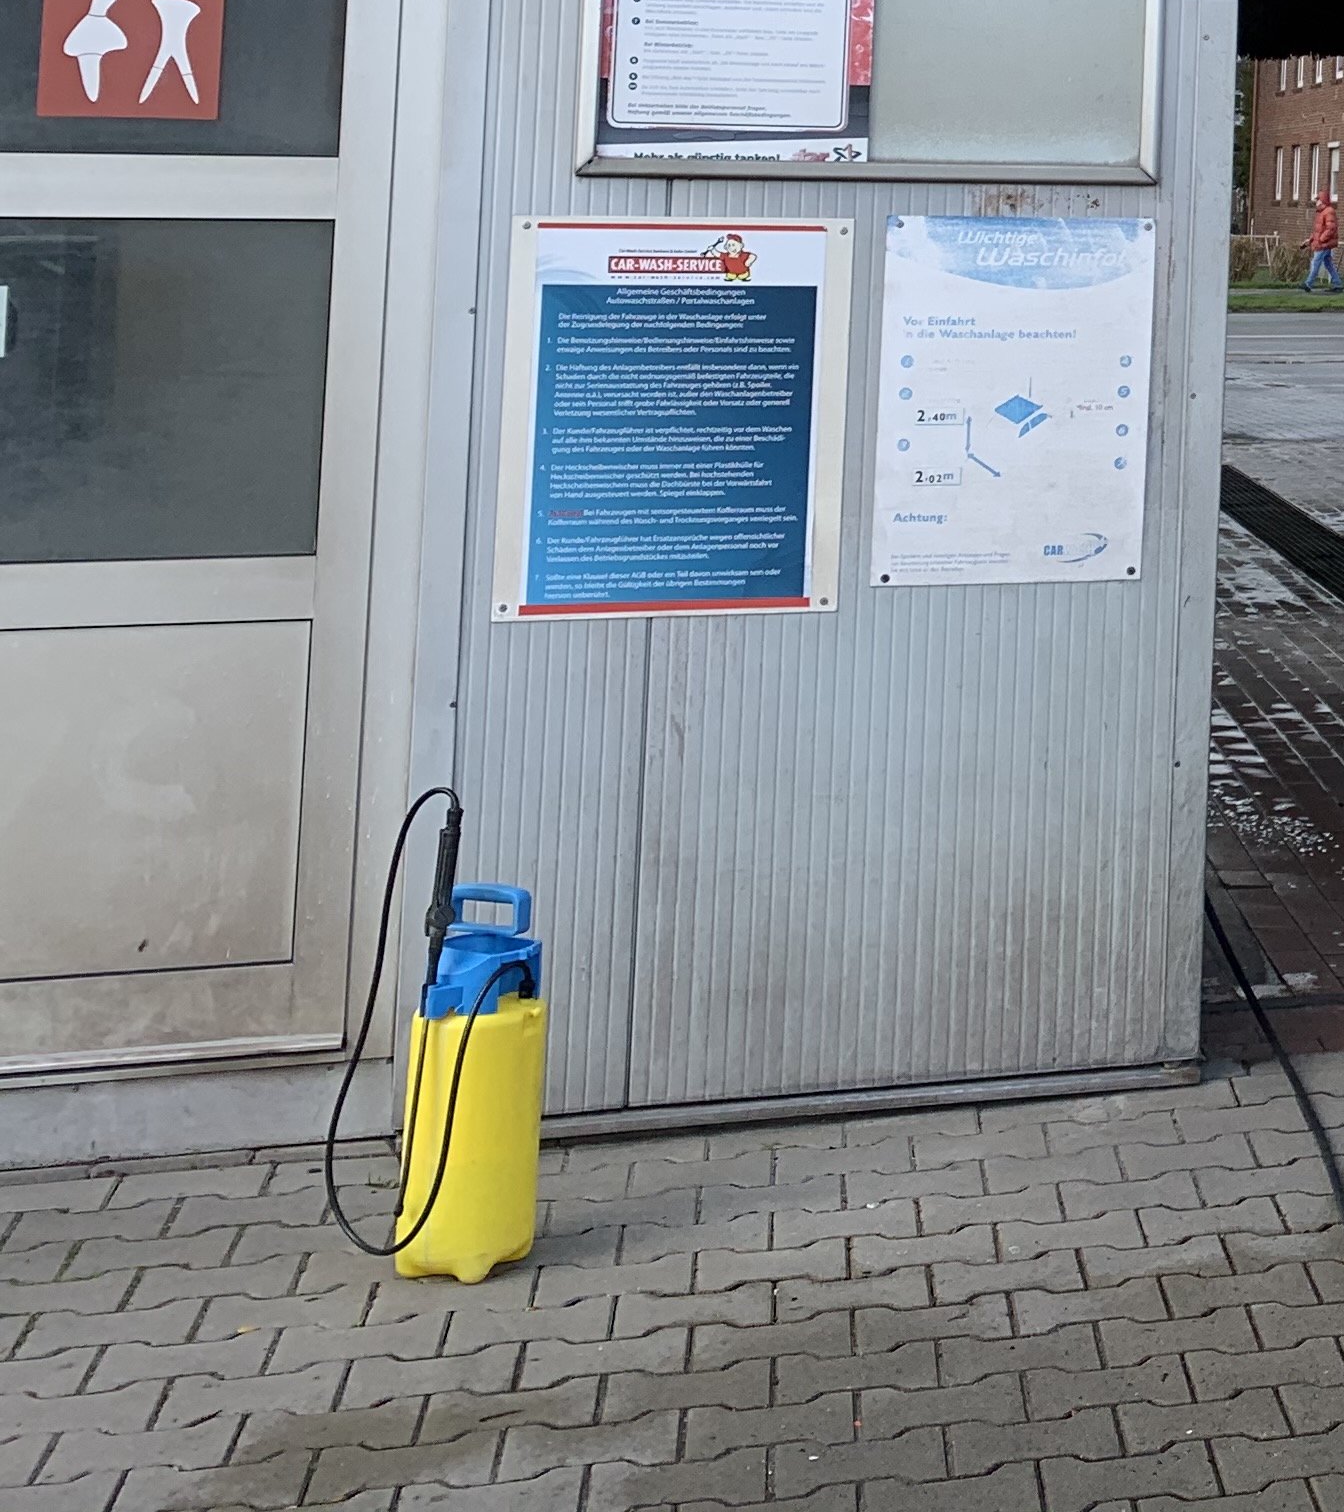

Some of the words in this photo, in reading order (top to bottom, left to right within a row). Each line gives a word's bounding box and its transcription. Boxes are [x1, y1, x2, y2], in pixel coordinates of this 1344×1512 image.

[958, 231, 1039, 248] Wichtige
[610, 258, 722, 271] CAR-WASH-SERVICE
[616, 288, 659, 297] Allgemeine
[660, 288, 746, 297] Geschäftsbedingungen
[927, 316, 976, 326] Einfahrt
[917, 329, 935, 338] die
[939, 329, 1014, 342] Waschanlage
[1018, 329, 1077, 339] beachten!
[893, 513, 948, 524] Achtung:
